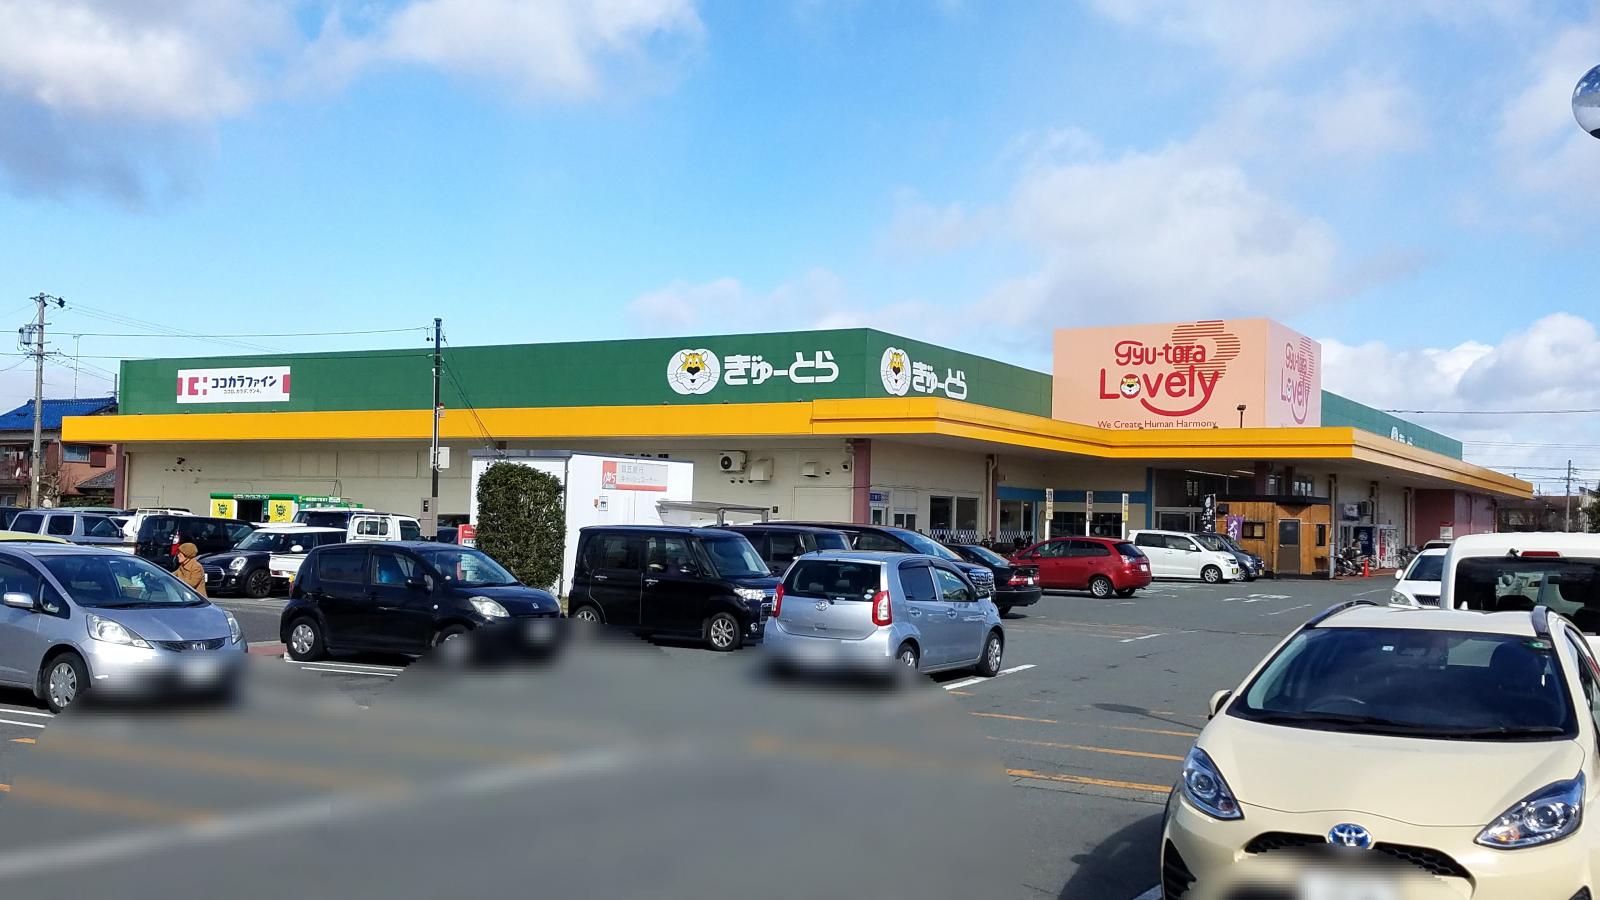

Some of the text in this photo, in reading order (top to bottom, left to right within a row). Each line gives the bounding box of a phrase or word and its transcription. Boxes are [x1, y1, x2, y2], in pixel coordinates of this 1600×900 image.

[723, 350, 840, 386] ぎゅーとら
[1115, 340, 1206, 366] gyu-tora
[211, 375, 277, 389] ココカラファイン
[912, 360, 968, 401] ぎゅーとら
[1099, 364, 1220, 417] Lovely
[1097, 418, 1217, 429] We Create Human Harmony
